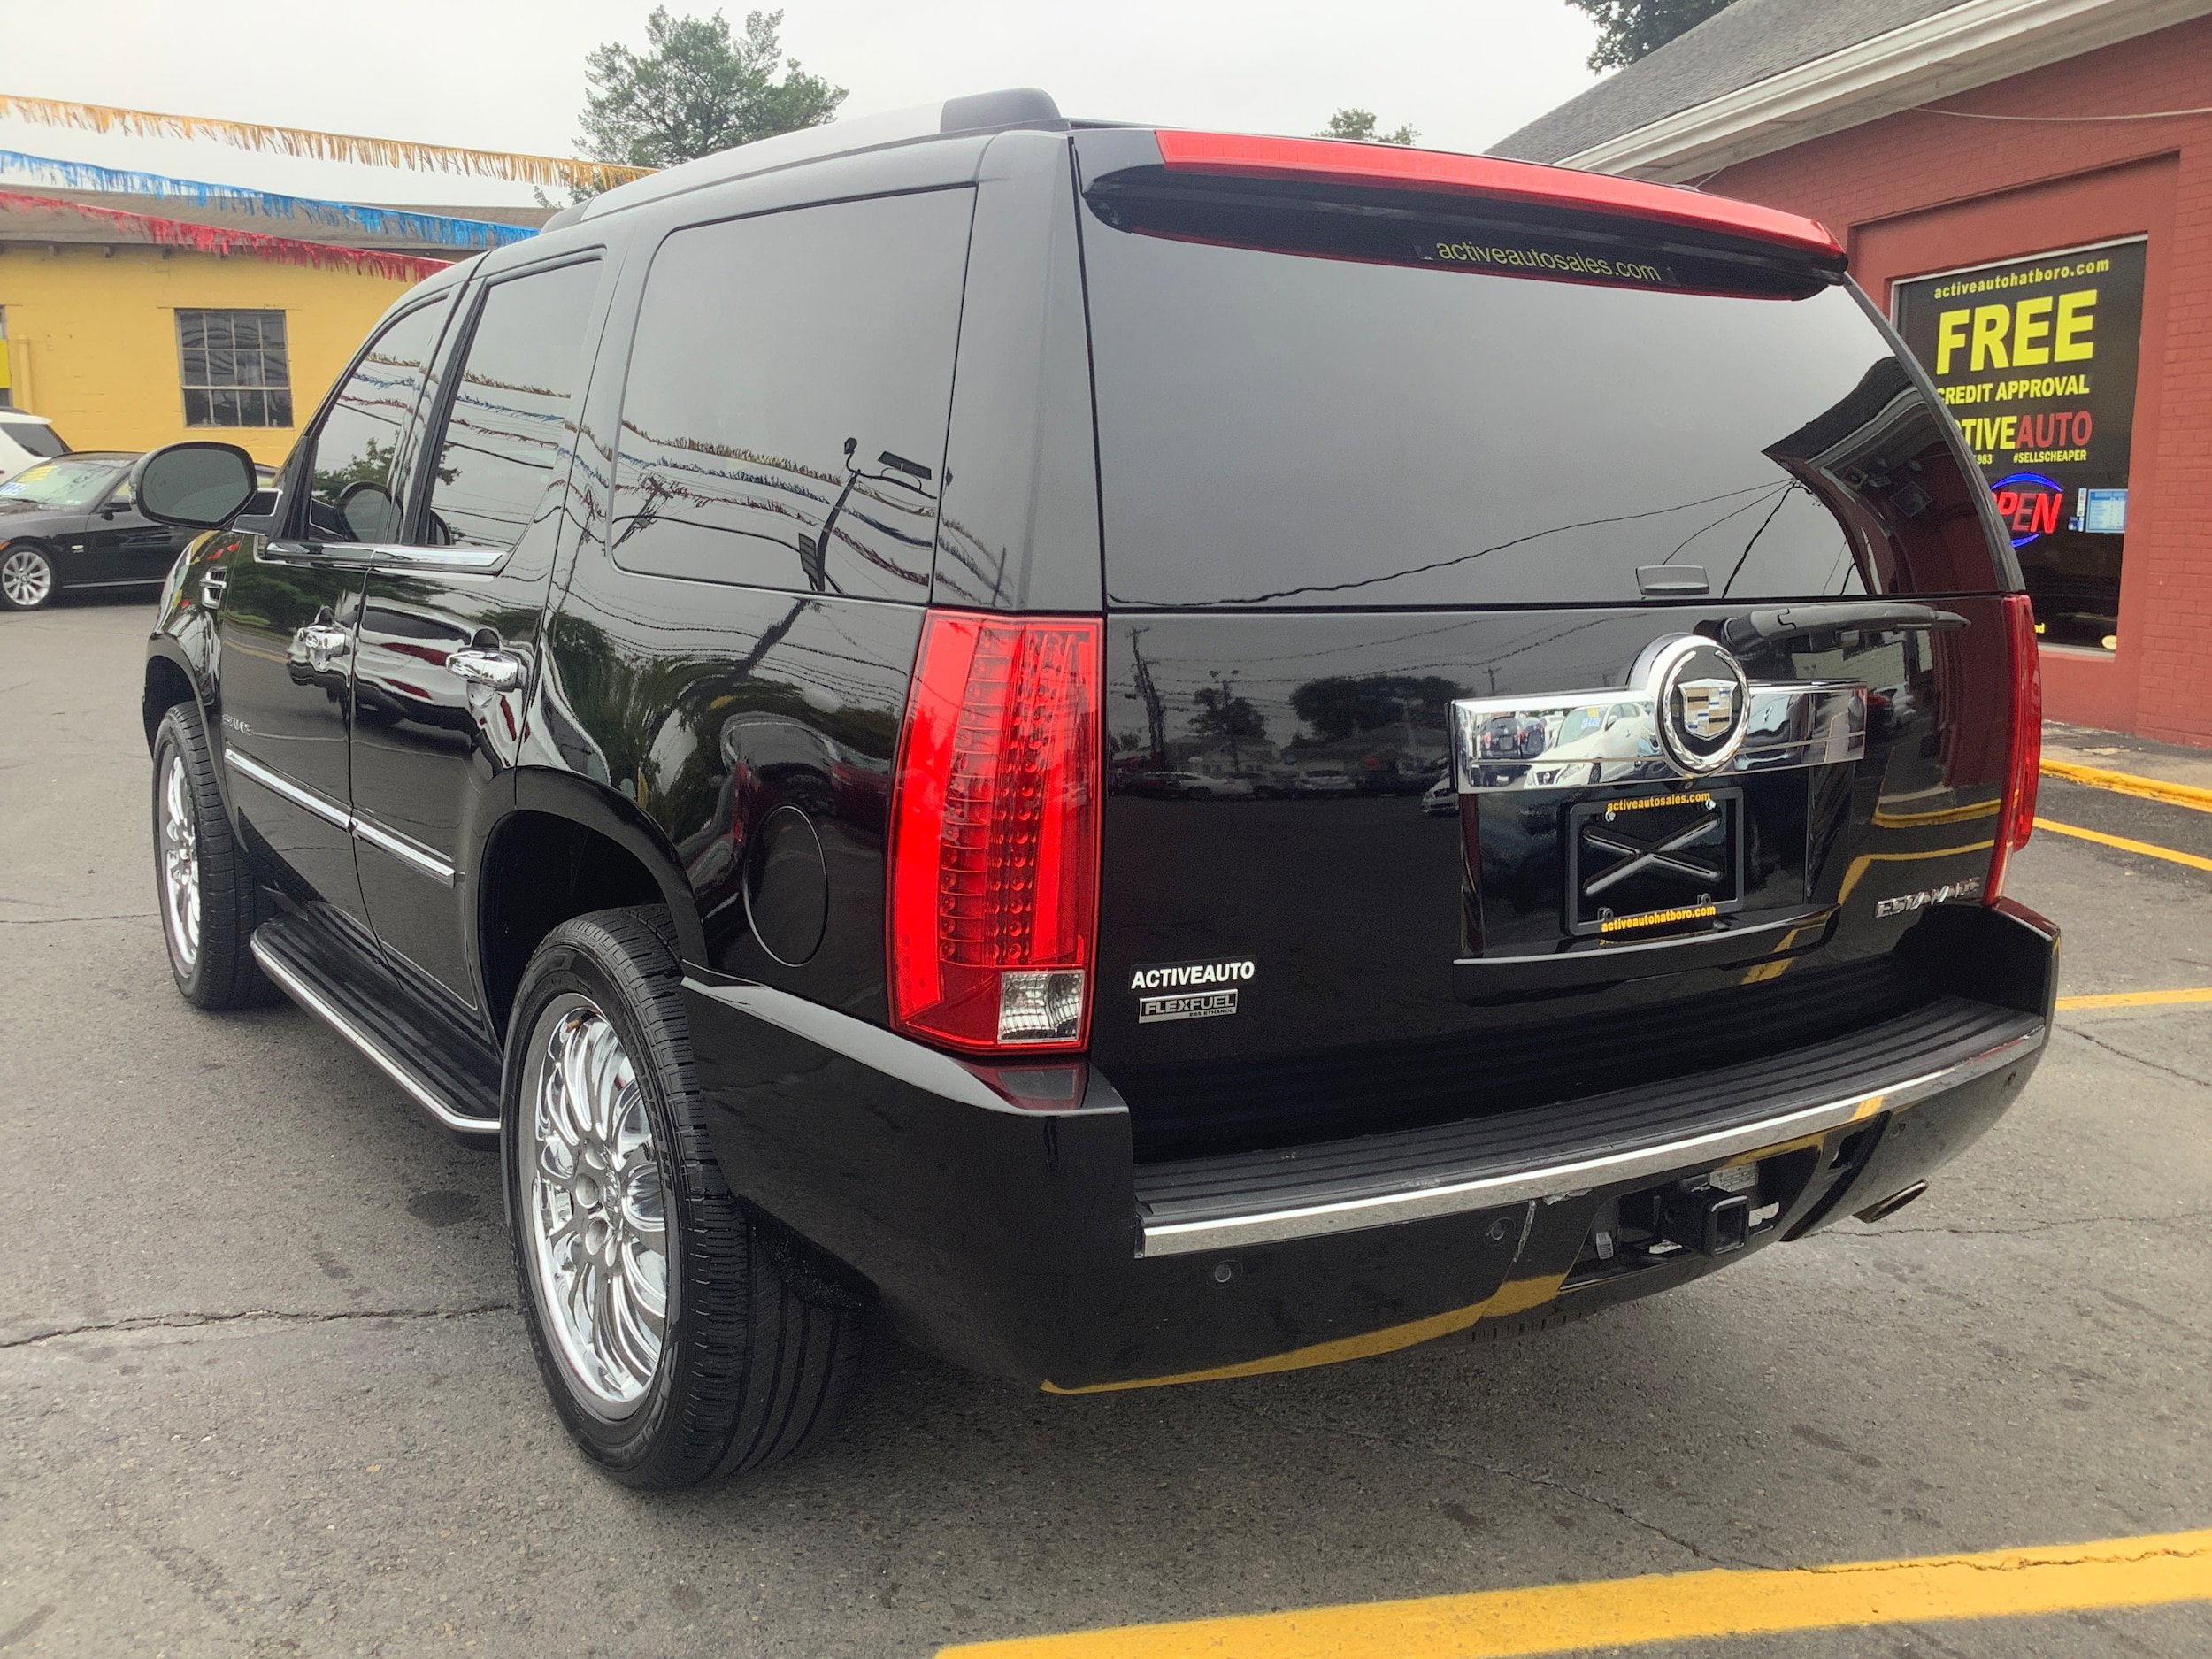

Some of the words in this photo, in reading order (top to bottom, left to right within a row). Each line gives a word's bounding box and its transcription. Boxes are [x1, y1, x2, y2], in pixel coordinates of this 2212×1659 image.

[1436, 241, 1663, 282] activeautosales.com
[1934, 258, 2110, 299] activeautohatboro.com
[1936, 289, 2098, 375] FREE
[1995, 374, 2090, 401] APPROVAL
[1955, 411, 2093, 450] TIVEAUTO
[1973, 453, 1993, 465] 983
[2013, 449, 2087, 464] #SELLSCHEAPER
[1991, 491, 2063, 534] PEN
[1607, 792, 1710, 812] activeautosales.com
[1601, 906, 1716, 933] activeautohatboro.com
[1131, 961, 1255, 989] ACTIVEAUTO
[1145, 995, 1235, 1015] FLEXFUEL
